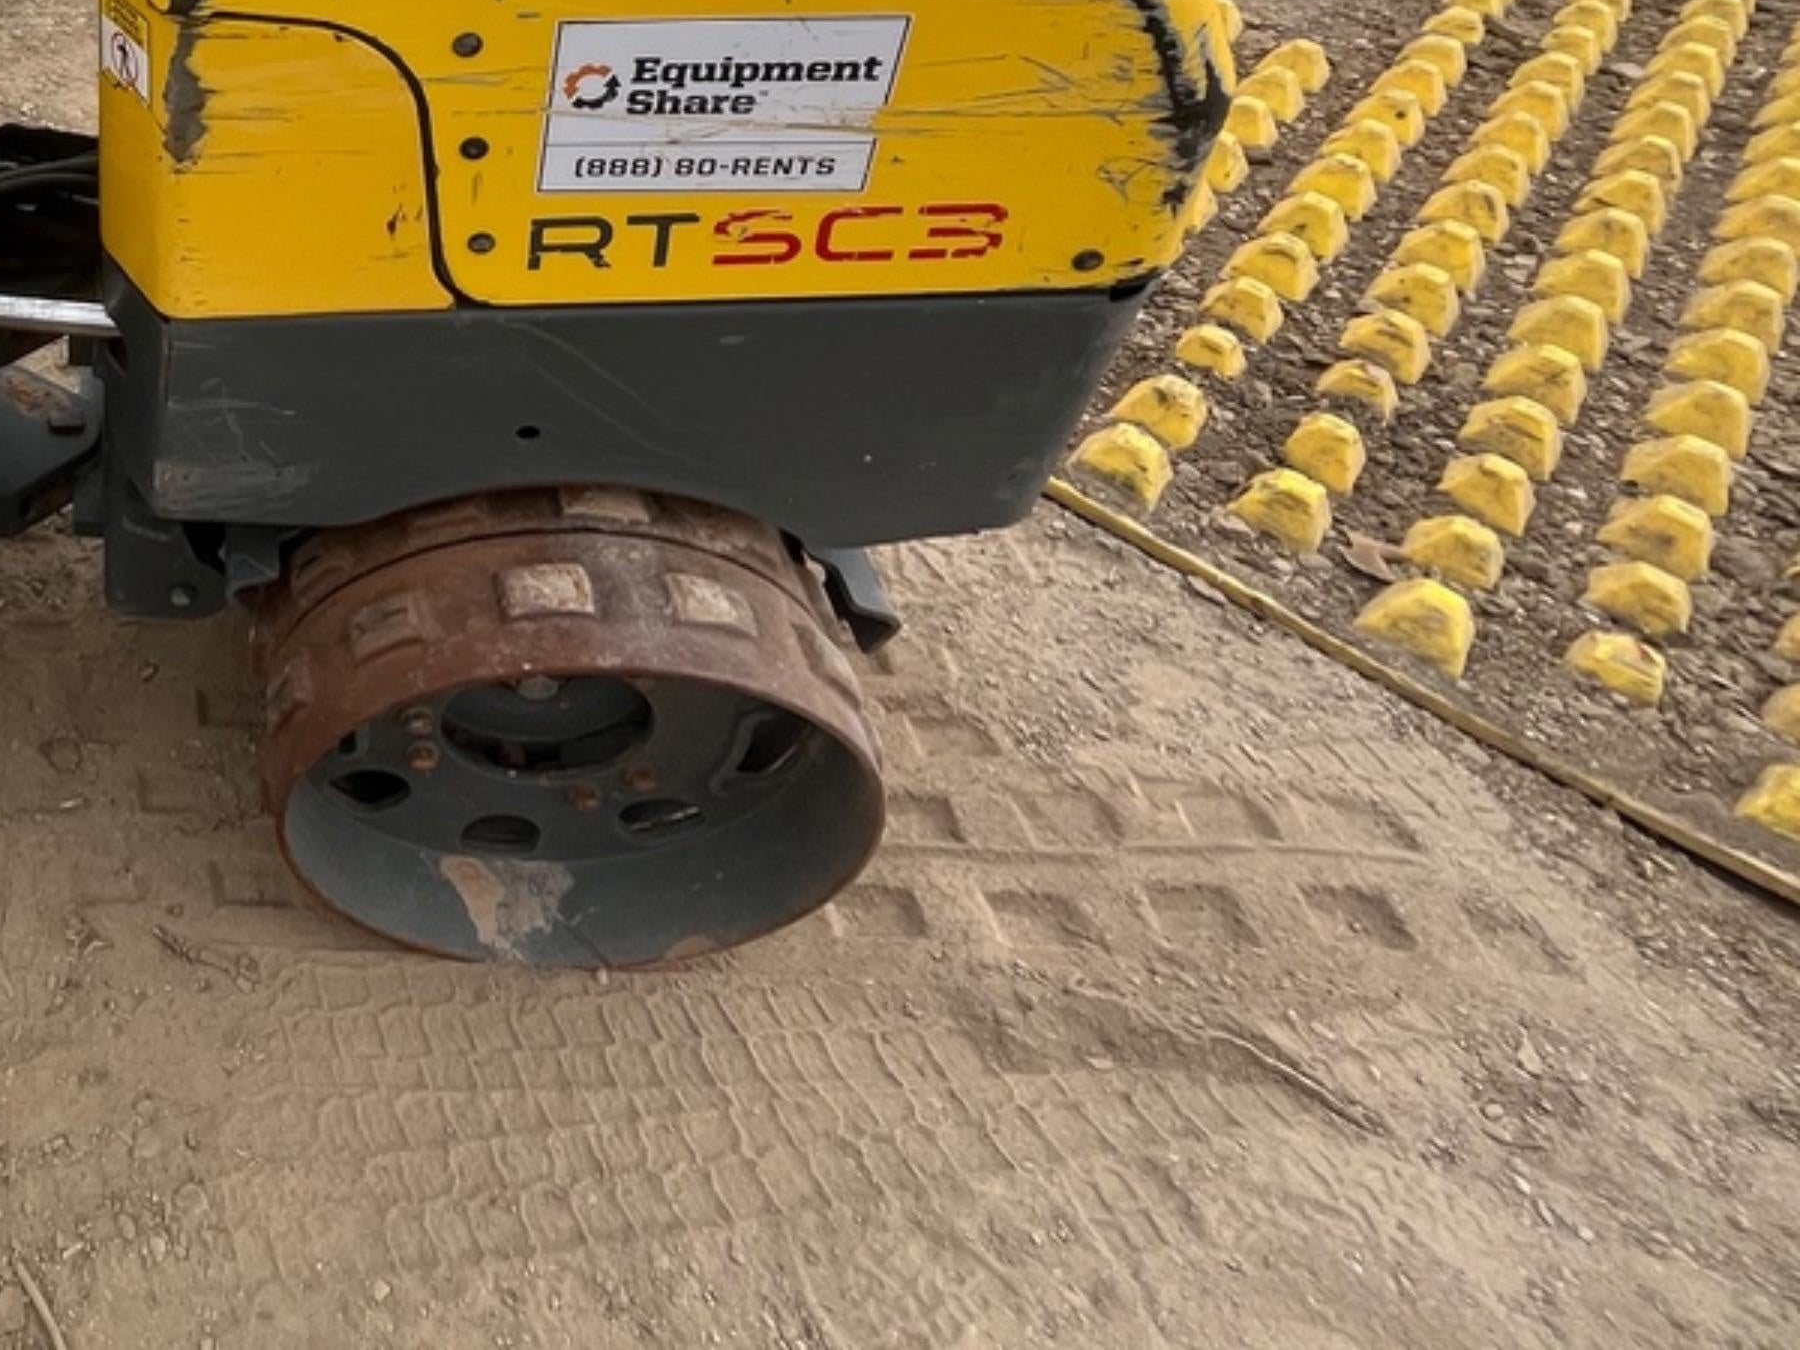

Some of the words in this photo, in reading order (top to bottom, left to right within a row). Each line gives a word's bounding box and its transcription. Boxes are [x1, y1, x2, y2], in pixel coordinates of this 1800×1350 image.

[631, 55, 883, 88] Equipment
[626, 88, 758, 115] Share
[574, 156, 663, 179] (888)
[675, 156, 836, 178] 80-RENTS
